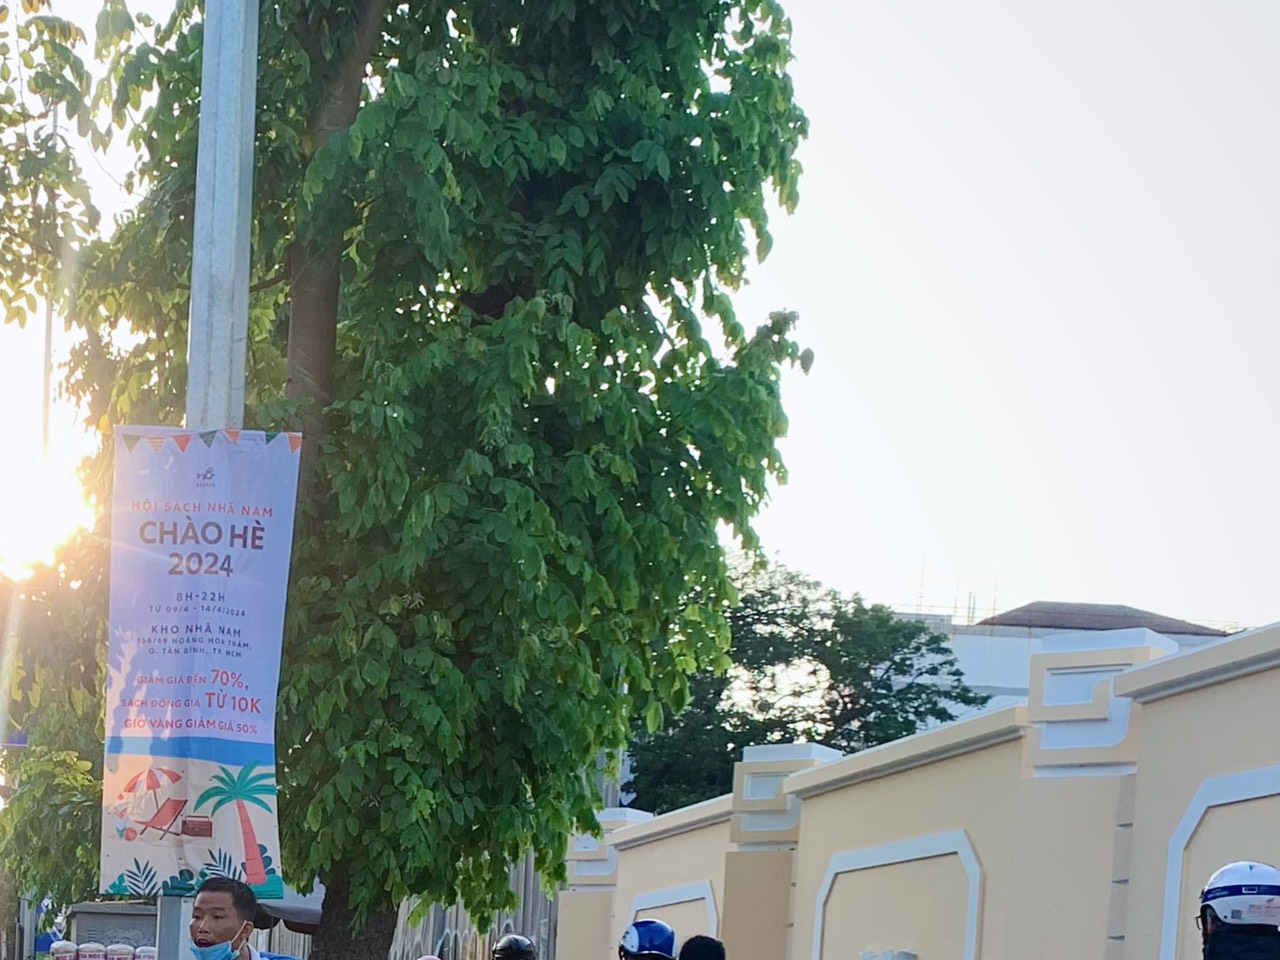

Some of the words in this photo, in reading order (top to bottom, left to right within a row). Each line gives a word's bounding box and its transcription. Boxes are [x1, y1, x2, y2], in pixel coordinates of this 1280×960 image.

[164, 499, 201, 512] SÁCH
[208, 501, 235, 514] NHÃ
[241, 506, 273, 518] NAM
[139, 515, 223, 545] CHÀO
[229, 519, 265, 550] HÈ
[168, 552, 233, 577] 2024
[176, 591, 225, 602] 8H-22H
[151, 624, 179, 634] KHO
[185, 622, 212, 634] NHÃ
[218, 625, 241, 638] NAM
[166, 675, 184, 685] GIÁ
[210, 669, 248, 690] 70%,
[121, 698, 147, 708] SÁCH
[184, 698, 200, 708] GIÁ
[205, 689, 228, 709] TỪ
[231, 695, 262, 714] 10K
[149, 717, 182, 729] VÀNG
[185, 716, 216, 729] GIẢM
[218, 720, 234, 732] GIÁ
[237, 723, 258, 734] 50%
